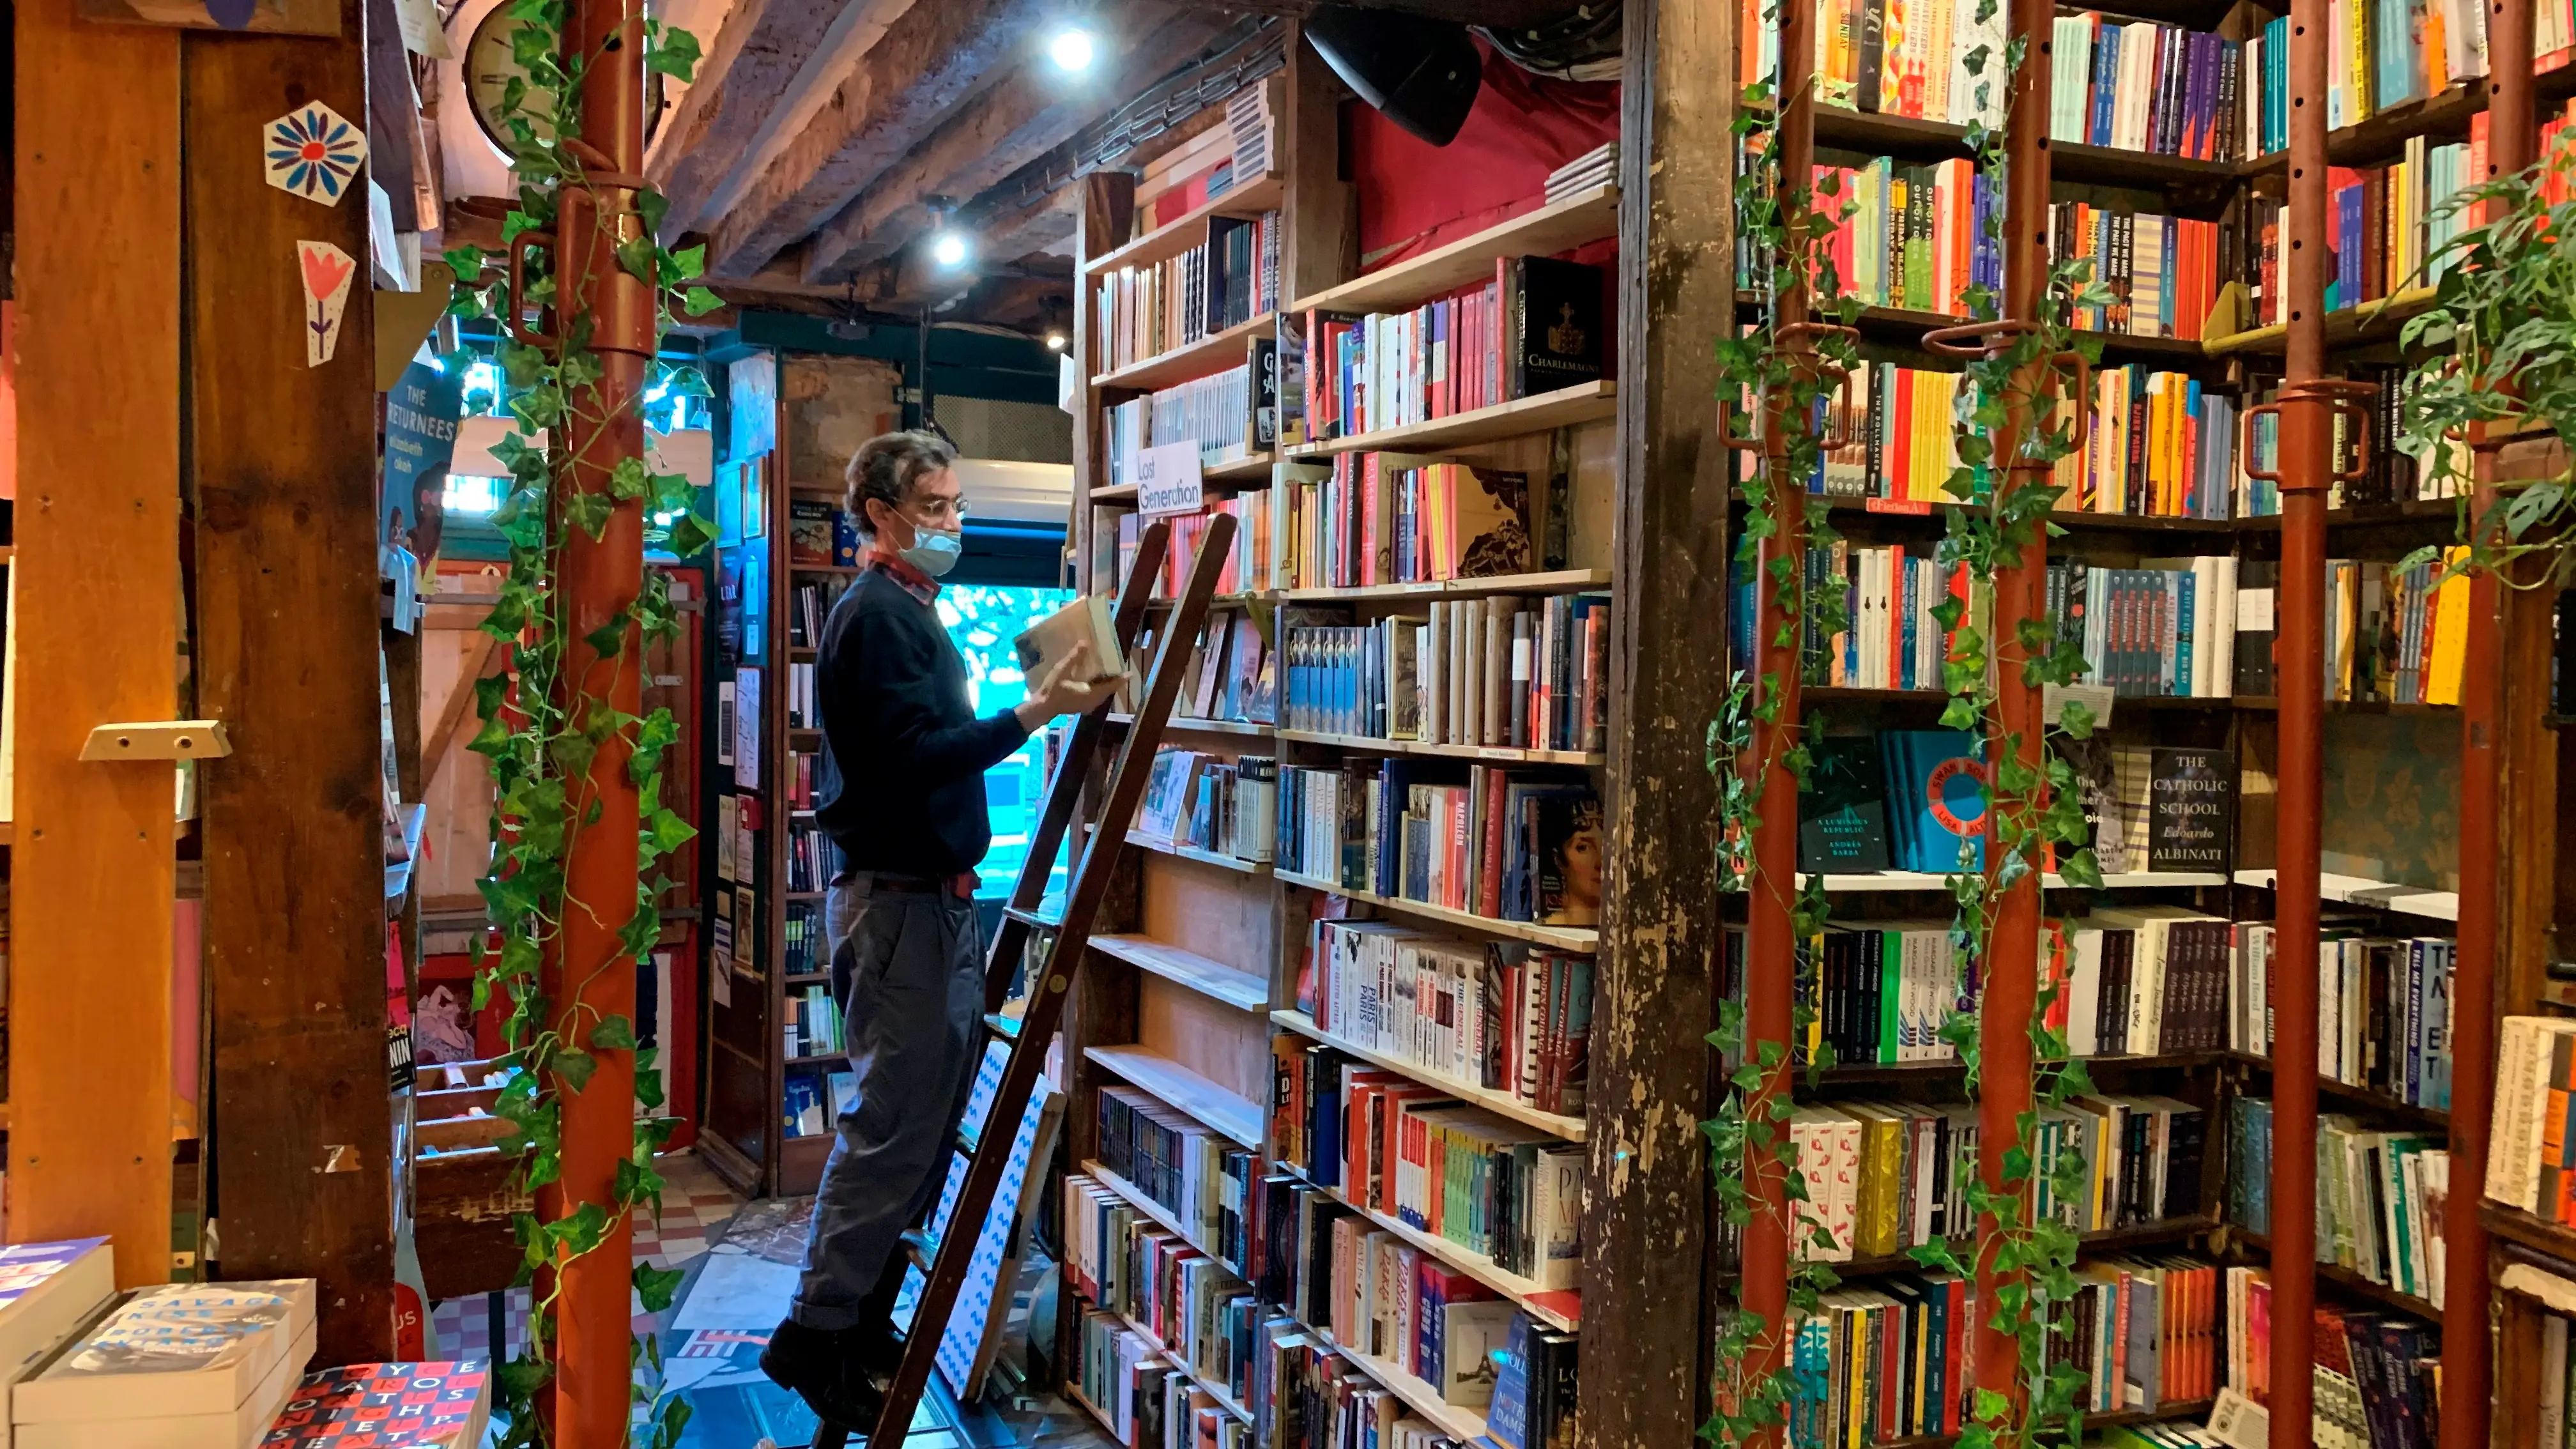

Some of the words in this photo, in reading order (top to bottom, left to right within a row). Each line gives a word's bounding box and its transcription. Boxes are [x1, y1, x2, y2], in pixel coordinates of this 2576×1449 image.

[1839, 12, 1850, 51] SUNDAY
[1920, 27, 1928, 54] DEEDS
[1913, 208, 1920, 222] OF
[1926, 210, 1933, 223] OF
[1912, 226, 1920, 259] TOUCH
[2112, 247, 2119, 257] WE
[2122, 248, 2129, 258] WE
[2110, 258, 2119, 277] MADE
[1528, 354, 1600, 373] CHARLEMAGNE
[406, 385, 427, 407] THE
[388, 401, 455, 441] RETURNEES
[1873, 415, 1882, 471] DOLLMAKER
[1137, 456, 1155, 480] Lost
[1140, 478, 1199, 509] Generation
[1876, 499, 1910, 512] Fiction
[1932, 762, 1957, 788] SWAN
[2175, 756, 2207, 768] THE
[2153, 778, 2228, 793] CATHOLIC
[1938, 811, 1958, 831] LISA
[2159, 802, 2221, 816] SCHOOL
[1456, 801, 1466, 847] NAPOLEON
[2163, 827, 2214, 839] Edoardo
[2153, 848, 2222, 861] ALBINATI
[2251, 934, 2260, 980] William
[2412, 949, 2421, 967] TELL
[1540, 962, 1549, 1006] SUDDEN
[1559, 965, 1569, 1008] SUDDEN
[2412, 970, 2420, 985] ME
[1360, 985, 1368, 1021] PARIS
[1367, 987, 1377, 1024] PARIS
[2251, 983, 2260, 1011] Boyd
[1455, 1003, 1464, 1050] GENERAL
[1475, 1007, 1483, 1055] GENERAL
[1538, 1007, 1548, 1055] COURAGE
[2410, 988, 2419, 1048] EVERYTHING
[1556, 1009, 1566, 1058] COURAGE
[1356, 1241, 1365, 1281] PARIS
[1381, 1251, 1391, 1303] PARIS
[1400, 1261, 1409, 1314] PARIS
[1496, 1409, 1527, 1436] DAME
